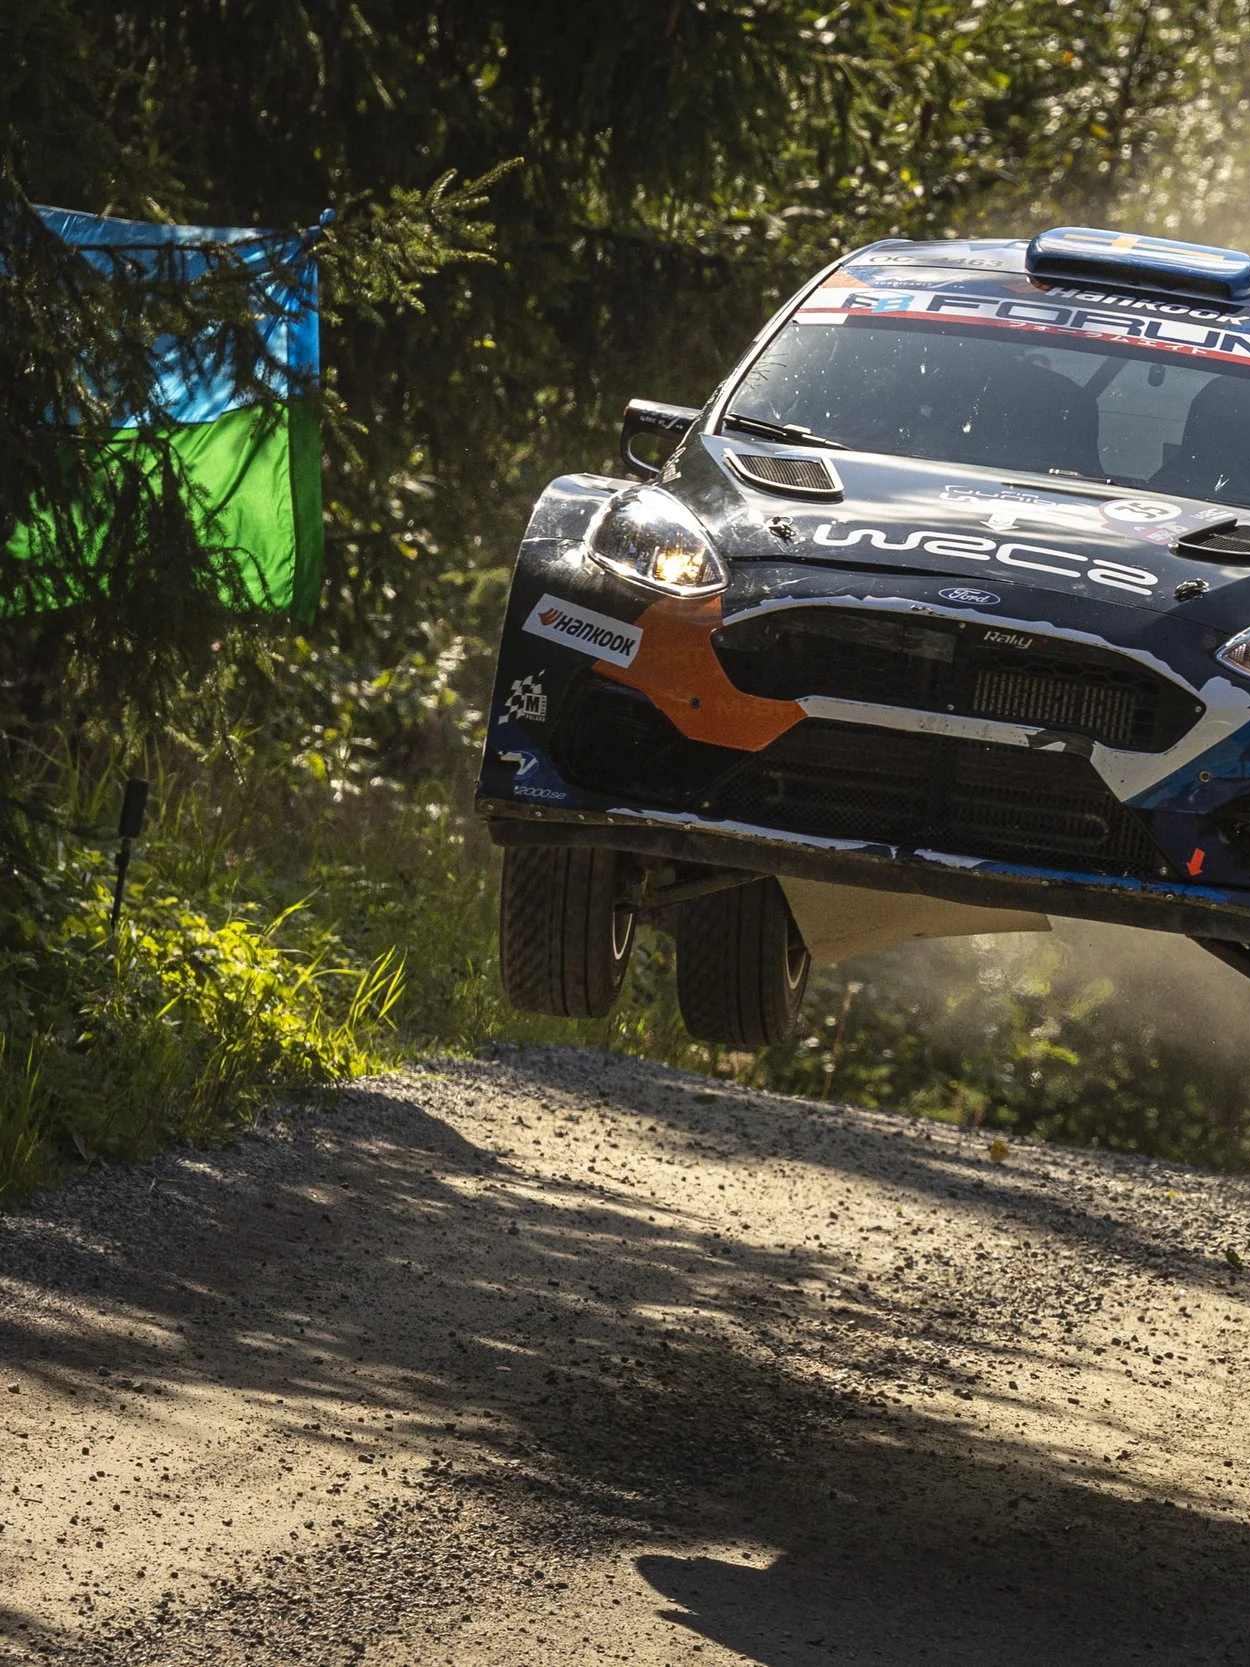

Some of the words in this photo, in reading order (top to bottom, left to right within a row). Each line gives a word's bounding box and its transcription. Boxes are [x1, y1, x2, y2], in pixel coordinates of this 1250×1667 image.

[1008, 320, 1207, 356] フォーラムエイト
[1113, 503, 1169, 519] 35
[812, 523, 1159, 596] WRC2
[948, 587, 991, 604] Ford
